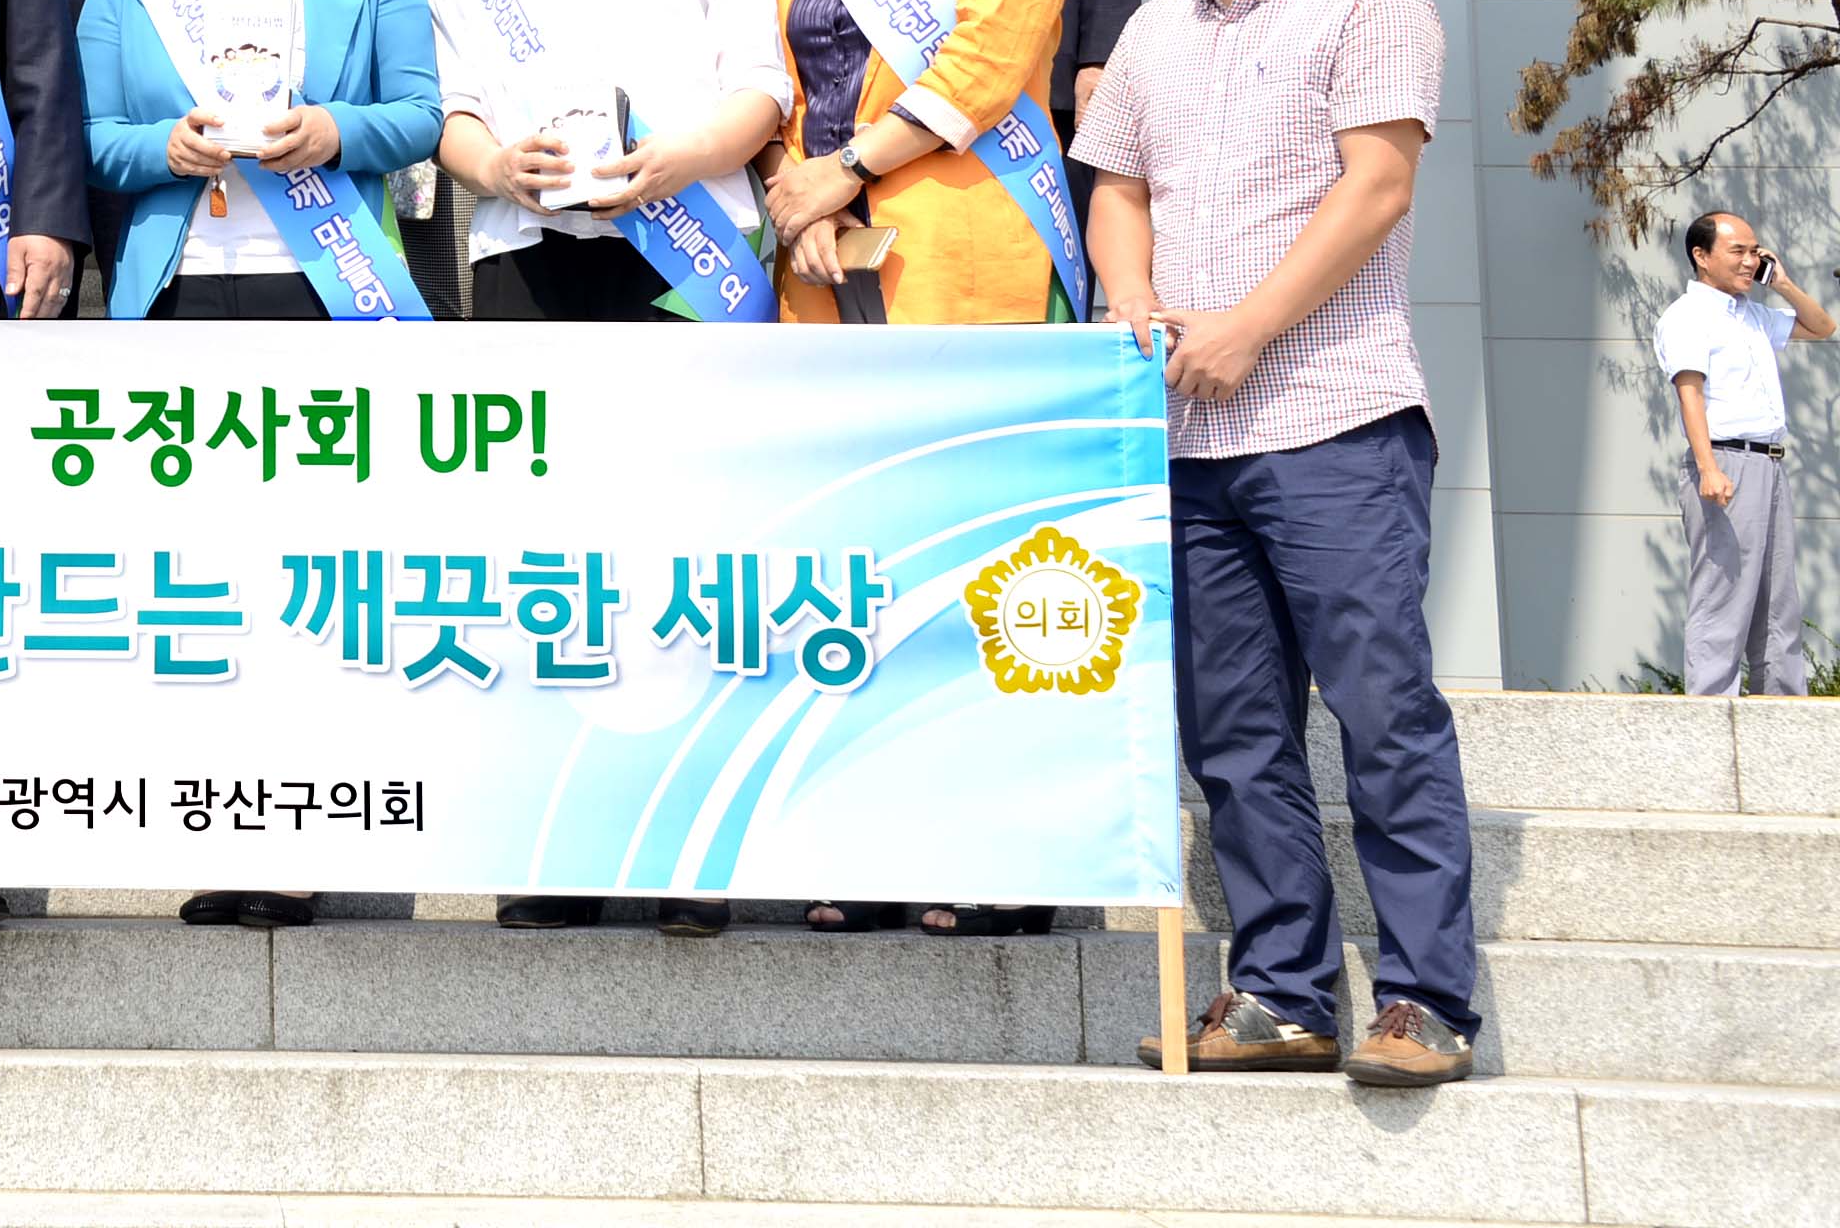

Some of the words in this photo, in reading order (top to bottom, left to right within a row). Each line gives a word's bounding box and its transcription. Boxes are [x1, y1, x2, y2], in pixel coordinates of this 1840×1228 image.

[31, 385, 371, 488] 공정사회
[419, 389, 549, 478] UP!
[281, 549, 620, 686] 깨끗한
[653, 553, 889, 689] 세상
[1014, 596, 1092, 639] 의회
[169, 777, 426, 832] 광산구의회
